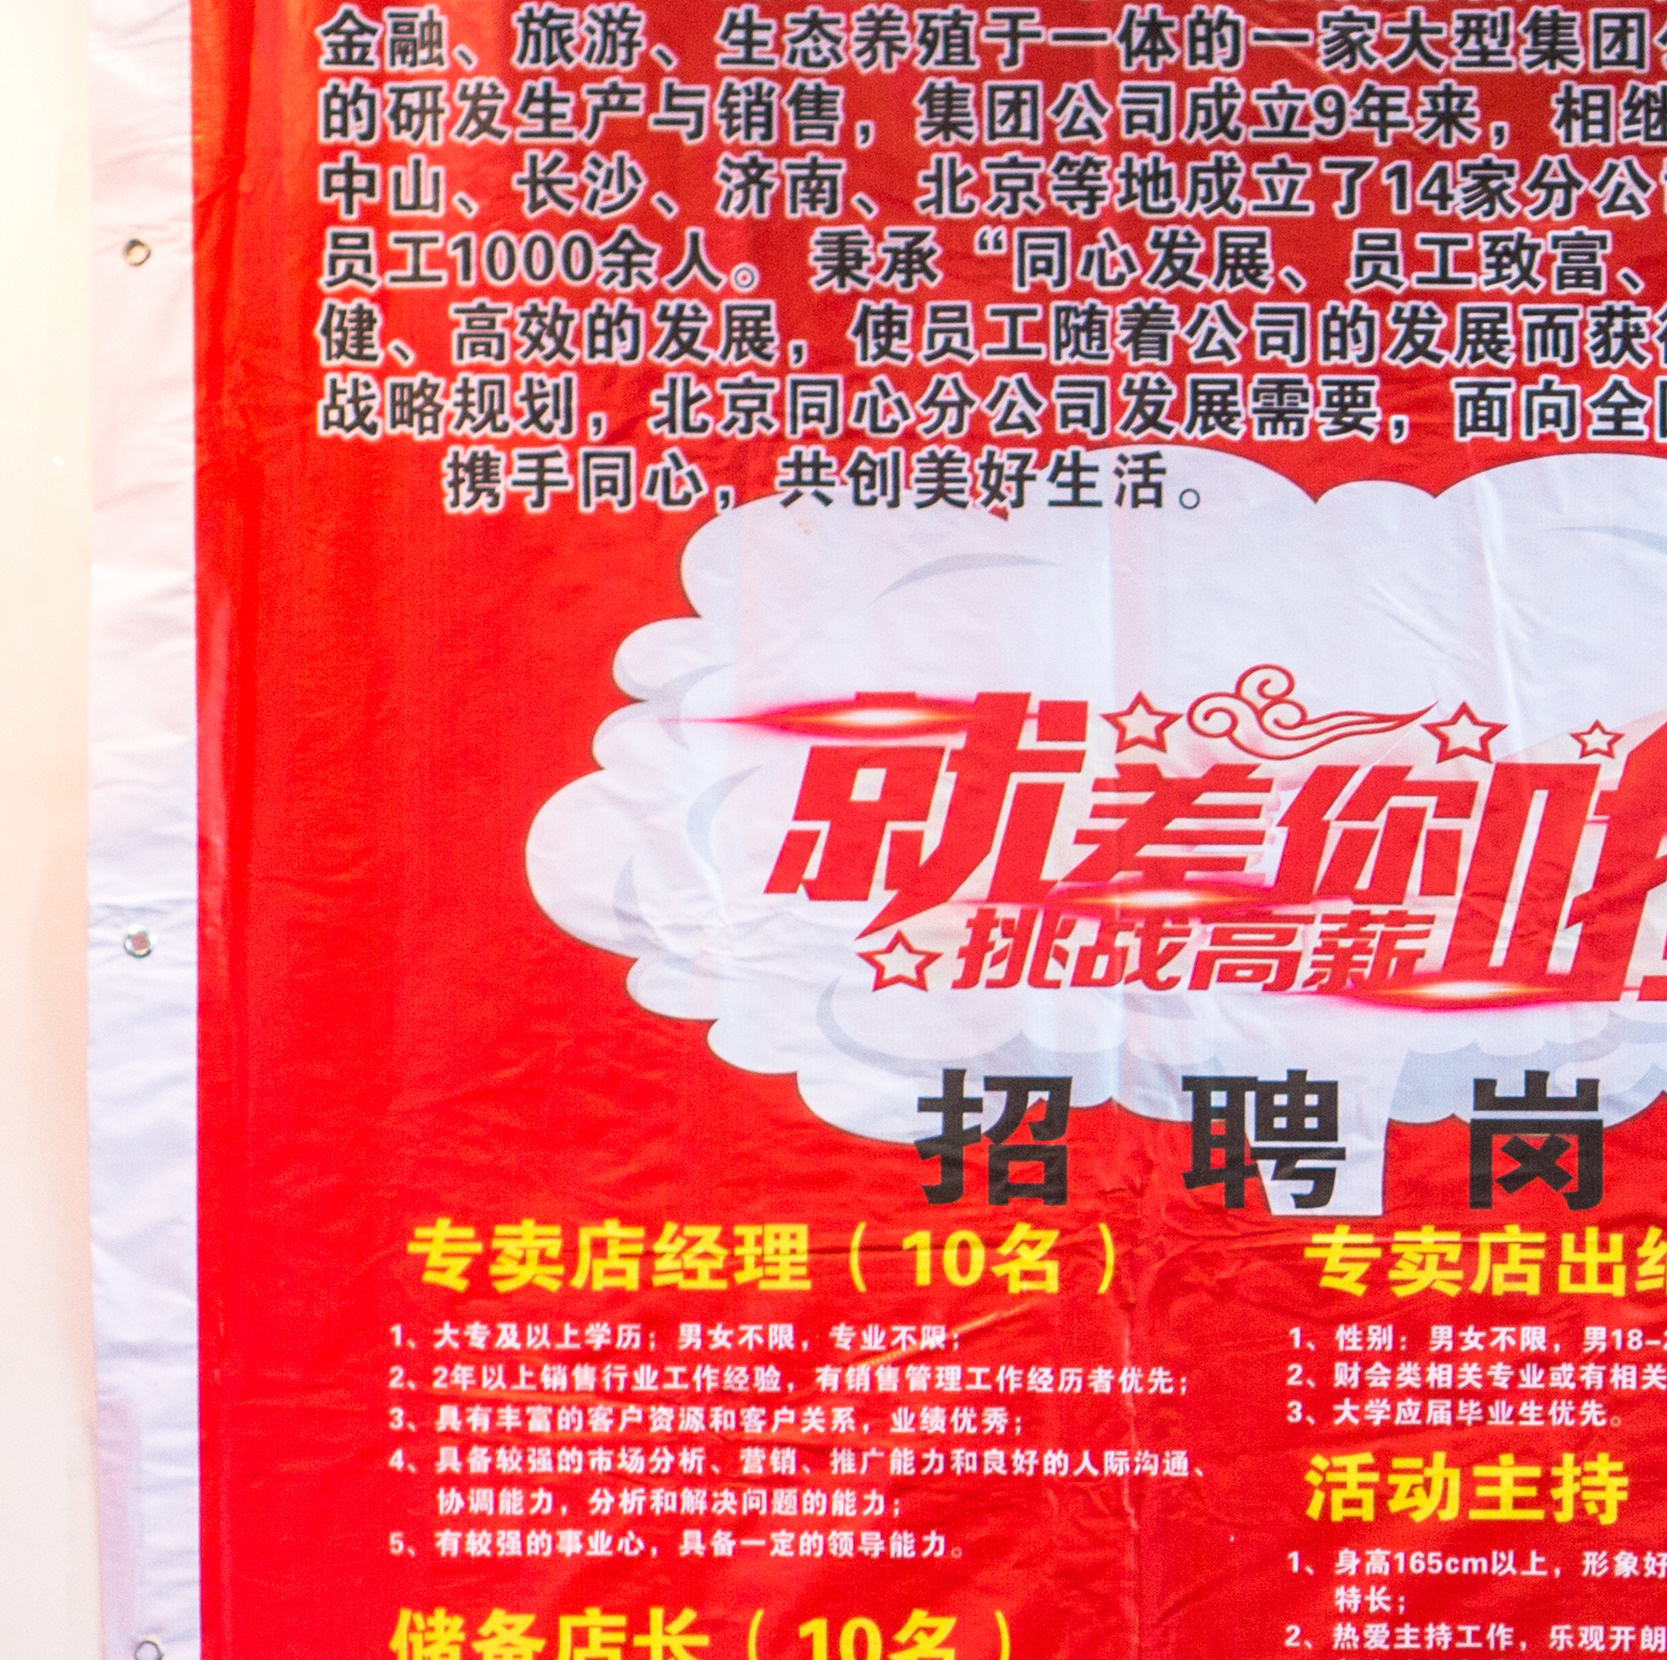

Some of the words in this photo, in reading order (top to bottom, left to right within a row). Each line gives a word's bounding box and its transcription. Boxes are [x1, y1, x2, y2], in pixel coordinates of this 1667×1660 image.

[444, 449, 1204, 514] 携手同心，共创美好生活。
[952, 905, 1434, 995] 挑战高薪
[406, 1217, 1116, 1295] 专卖店经理（10名）
[1287, 1397, 1621, 1427] 3、大学应届毕业生优先。
[437, 1487, 900, 1517] 协调能力，分析和解决问题的能力；
[1304, 1450, 1629, 1526] 活动主持
[390, 1528, 963, 1558] 5、有较强的事业心，具备一定的领导能力。
[1334, 1585, 1405, 1613] 特长；
